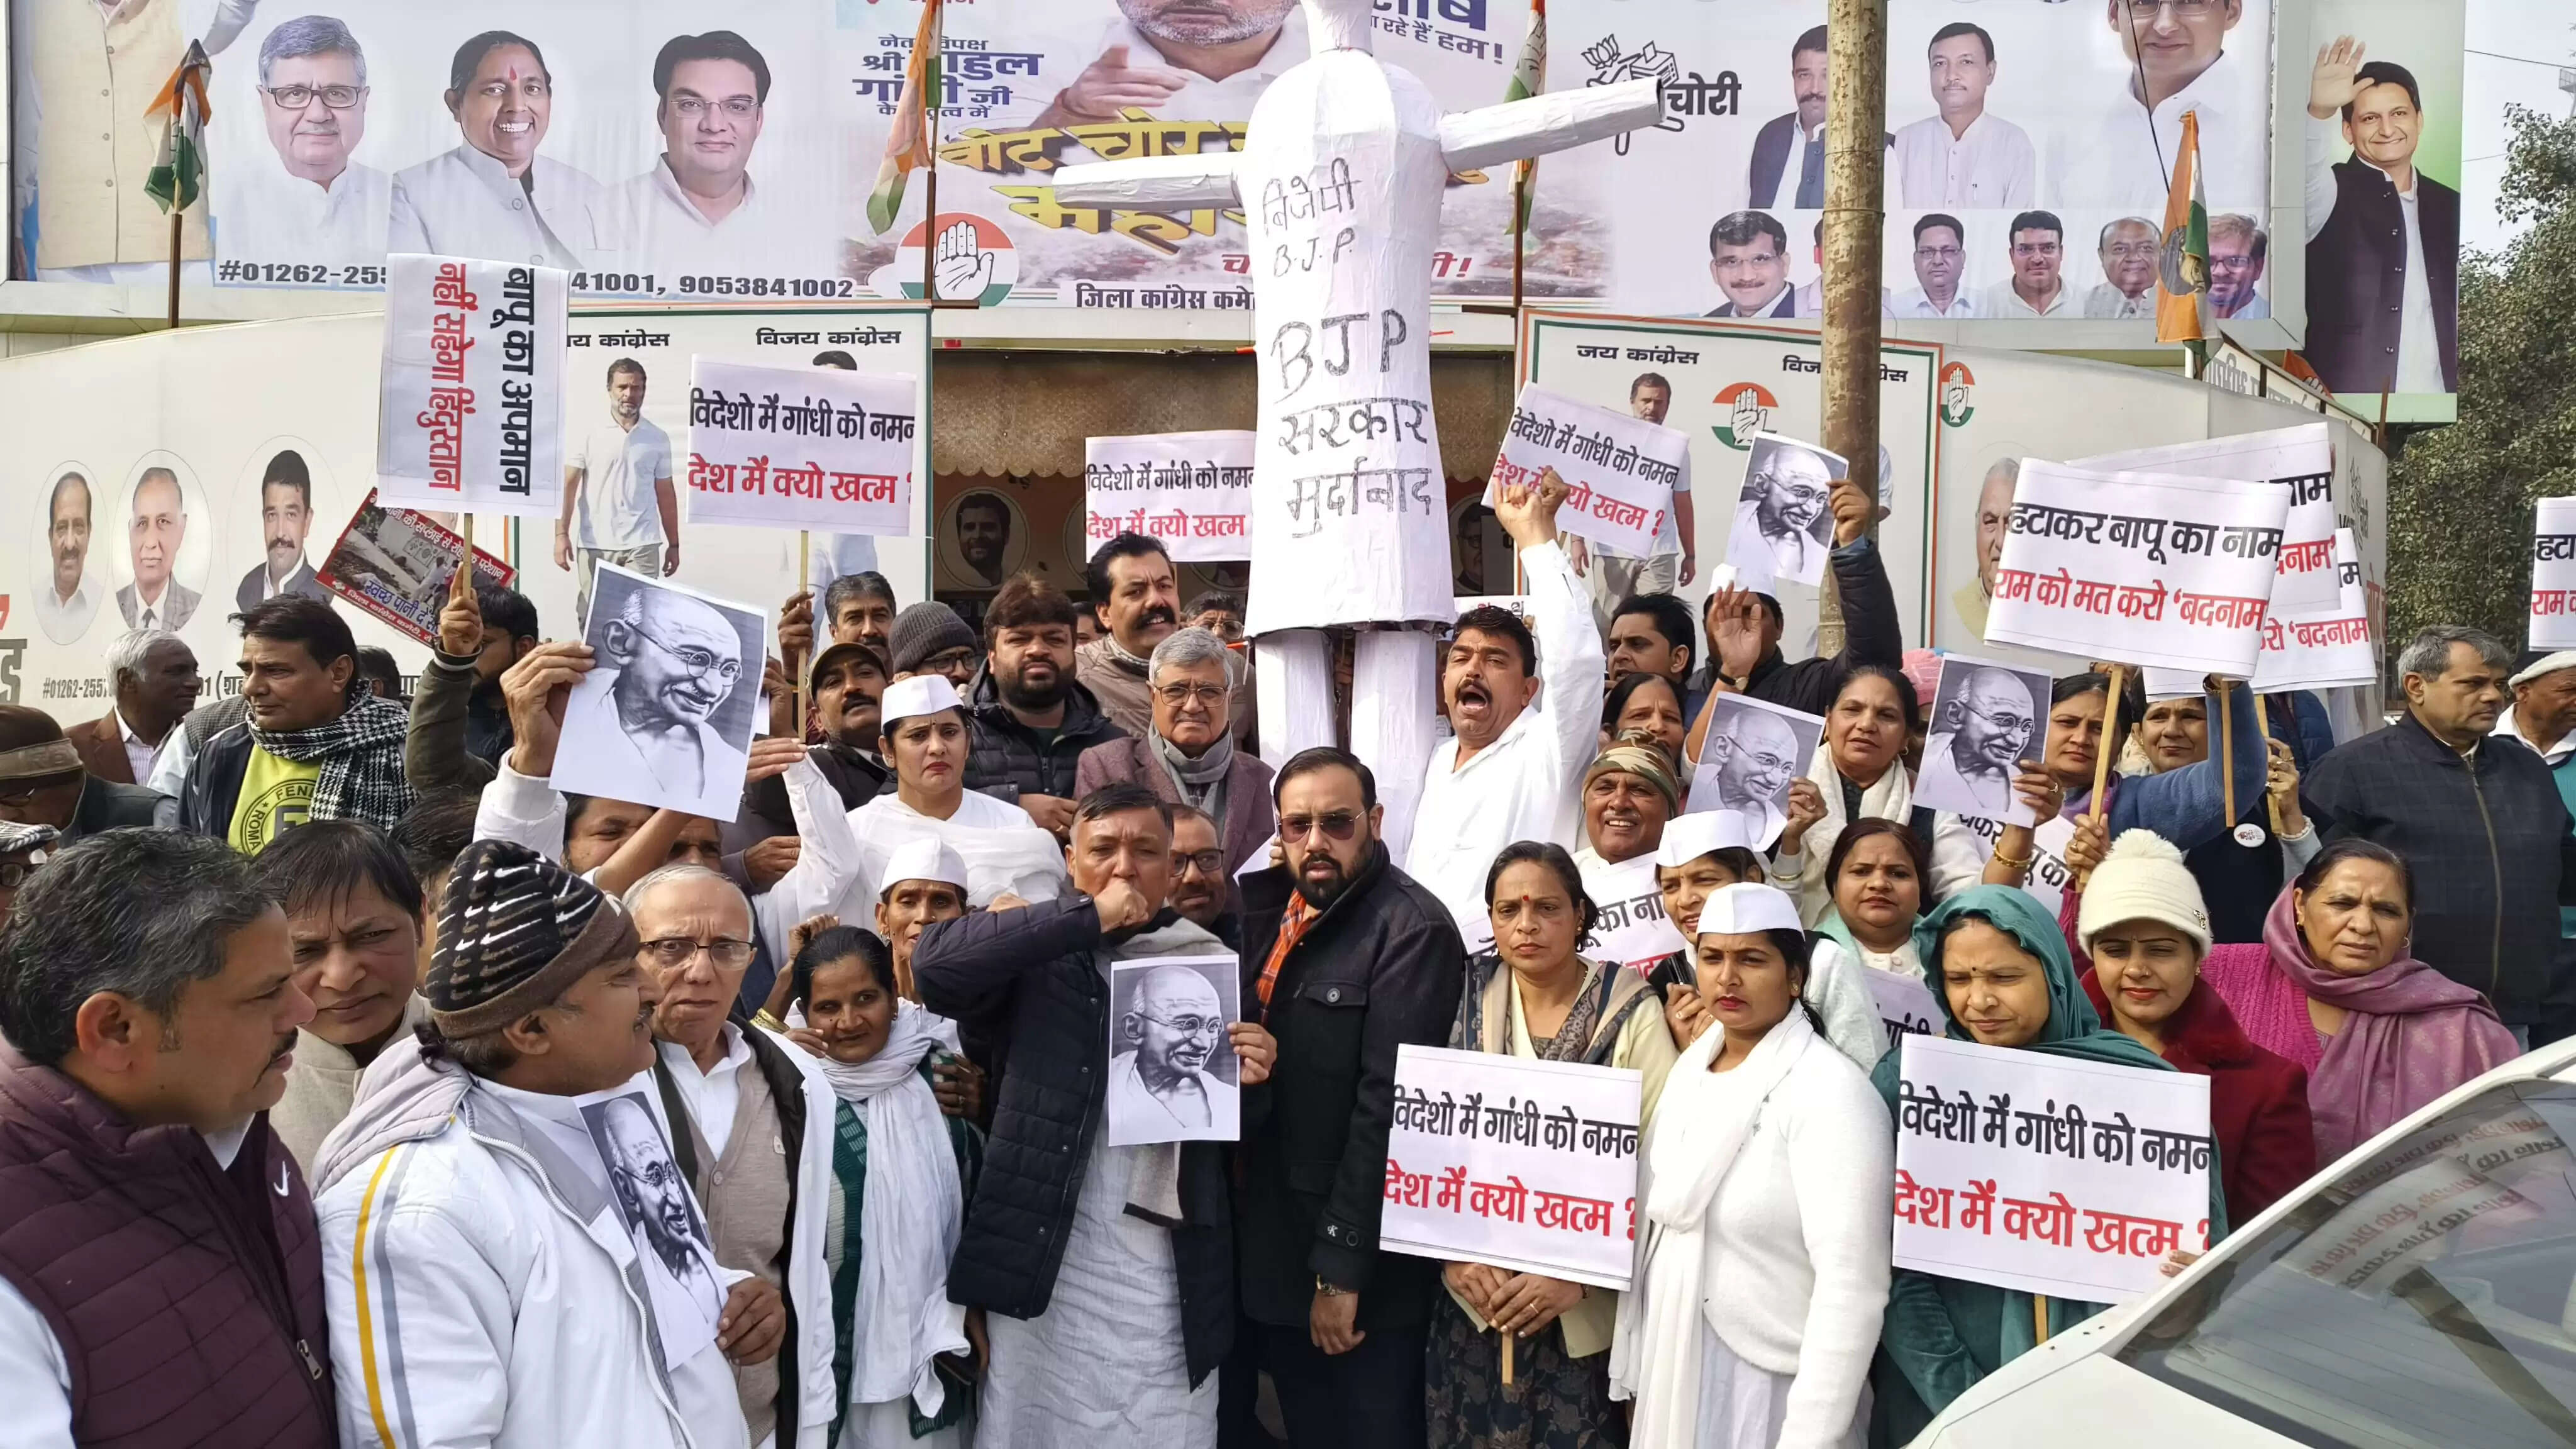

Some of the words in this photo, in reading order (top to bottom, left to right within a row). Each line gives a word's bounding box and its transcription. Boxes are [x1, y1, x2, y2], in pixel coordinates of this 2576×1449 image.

[879, 34, 914, 48] नेत
[1382, 17, 1409, 36] रहे
[1413, 21, 1433, 43] हैं
[862, 52, 905, 70] श्री
[968, 86, 1013, 105] जी
[968, 105, 992, 118] में
[1664, 71, 1741, 116] चोरी
[433, 263, 478, 311] नहीं
[490, 268, 535, 329] बापू
[679, 275, 853, 297] 9053841002
[1076, 282, 1134, 308] जिला
[1140, 284, 1207, 309] कांग्रेस
[1213, 286, 1255, 310] कमे
[431, 313, 475, 384] सहेगा
[502, 330, 534, 375] का
[599, 328, 670, 348] कांग्रेस
[756, 327, 820, 346] विजय
[828, 326, 901, 346] कांग्रेस
[1577, 345, 1619, 360] जय
[1626, 345, 1699, 365] कांग्रेस
[1782, 354, 1821, 374] विज
[689, 387, 755, 431] विदेशो
[758, 392, 780, 433] में
[782, 395, 833, 436] गांधी
[836, 402, 867, 440] को
[1278, 397, 1428, 456] सरकार
[416, 386, 476, 491] हिंदुस्तान
[499, 379, 532, 496] अपमान
[1555, 424, 1575, 453] में
[1572, 431, 1614, 468] गांधी
[1612, 446, 1640, 476] को
[687, 453, 735, 493] देश
[741, 455, 769, 495] में
[773, 461, 824, 499] क्यो
[830, 472, 898, 504] खत्म
[1136, 460, 1152, 490] में
[1154, 459, 1192, 490] गांधी
[1195, 460, 1218, 489] को
[1286, 456, 1433, 539] मुर्दाबाद
[1592, 492, 1649, 531] खत्म
[1651, 509, 1665, 538] ?
[1087, 511, 1122, 538] देश
[1192, 514, 1246, 537] खत्म
[2009, 502, 2108, 544] हटाकर
[2109, 514, 2168, 565] बापू
[2171, 521, 2219, 556] का
[2222, 526, 2285, 562] नाम
[394, 596, 419, 619] पानी
[1994, 569, 2035, 601] राम
[2036, 567, 2072, 608] को
[2074, 580, 2116, 614] मत
[2118, 579, 2168, 622] करो
[2531, 590, 2567, 615] राम
[248, 809, 265, 850] ROMA
[1630, 891, 1665, 921] ना
[1390, 1084, 1456, 1136] विदेशो
[1459, 1092, 1482, 1139] में
[1484, 1096, 1540, 1147] गांधी
[1543, 1106, 1578, 1152] को
[1899, 1080, 1978, 1144] विदेशो
[1982, 1093, 2011, 1148] में
[2014, 1099, 2087, 1160] गांधी
[2092, 1112, 2135, 1167] को
[1384, 1158, 1433, 1208] देश
[1436, 1165, 1467, 1213] में
[1470, 1175, 1528, 1224] क्यो
[1534, 1190, 1614, 1237] खत्म
[1894, 1169, 1954, 1230] देश
[1960, 1179, 1997, 1235] में
[2003, 1192, 2077, 1248] क्यो
[2083, 1209, 2183, 1258] खत्म
